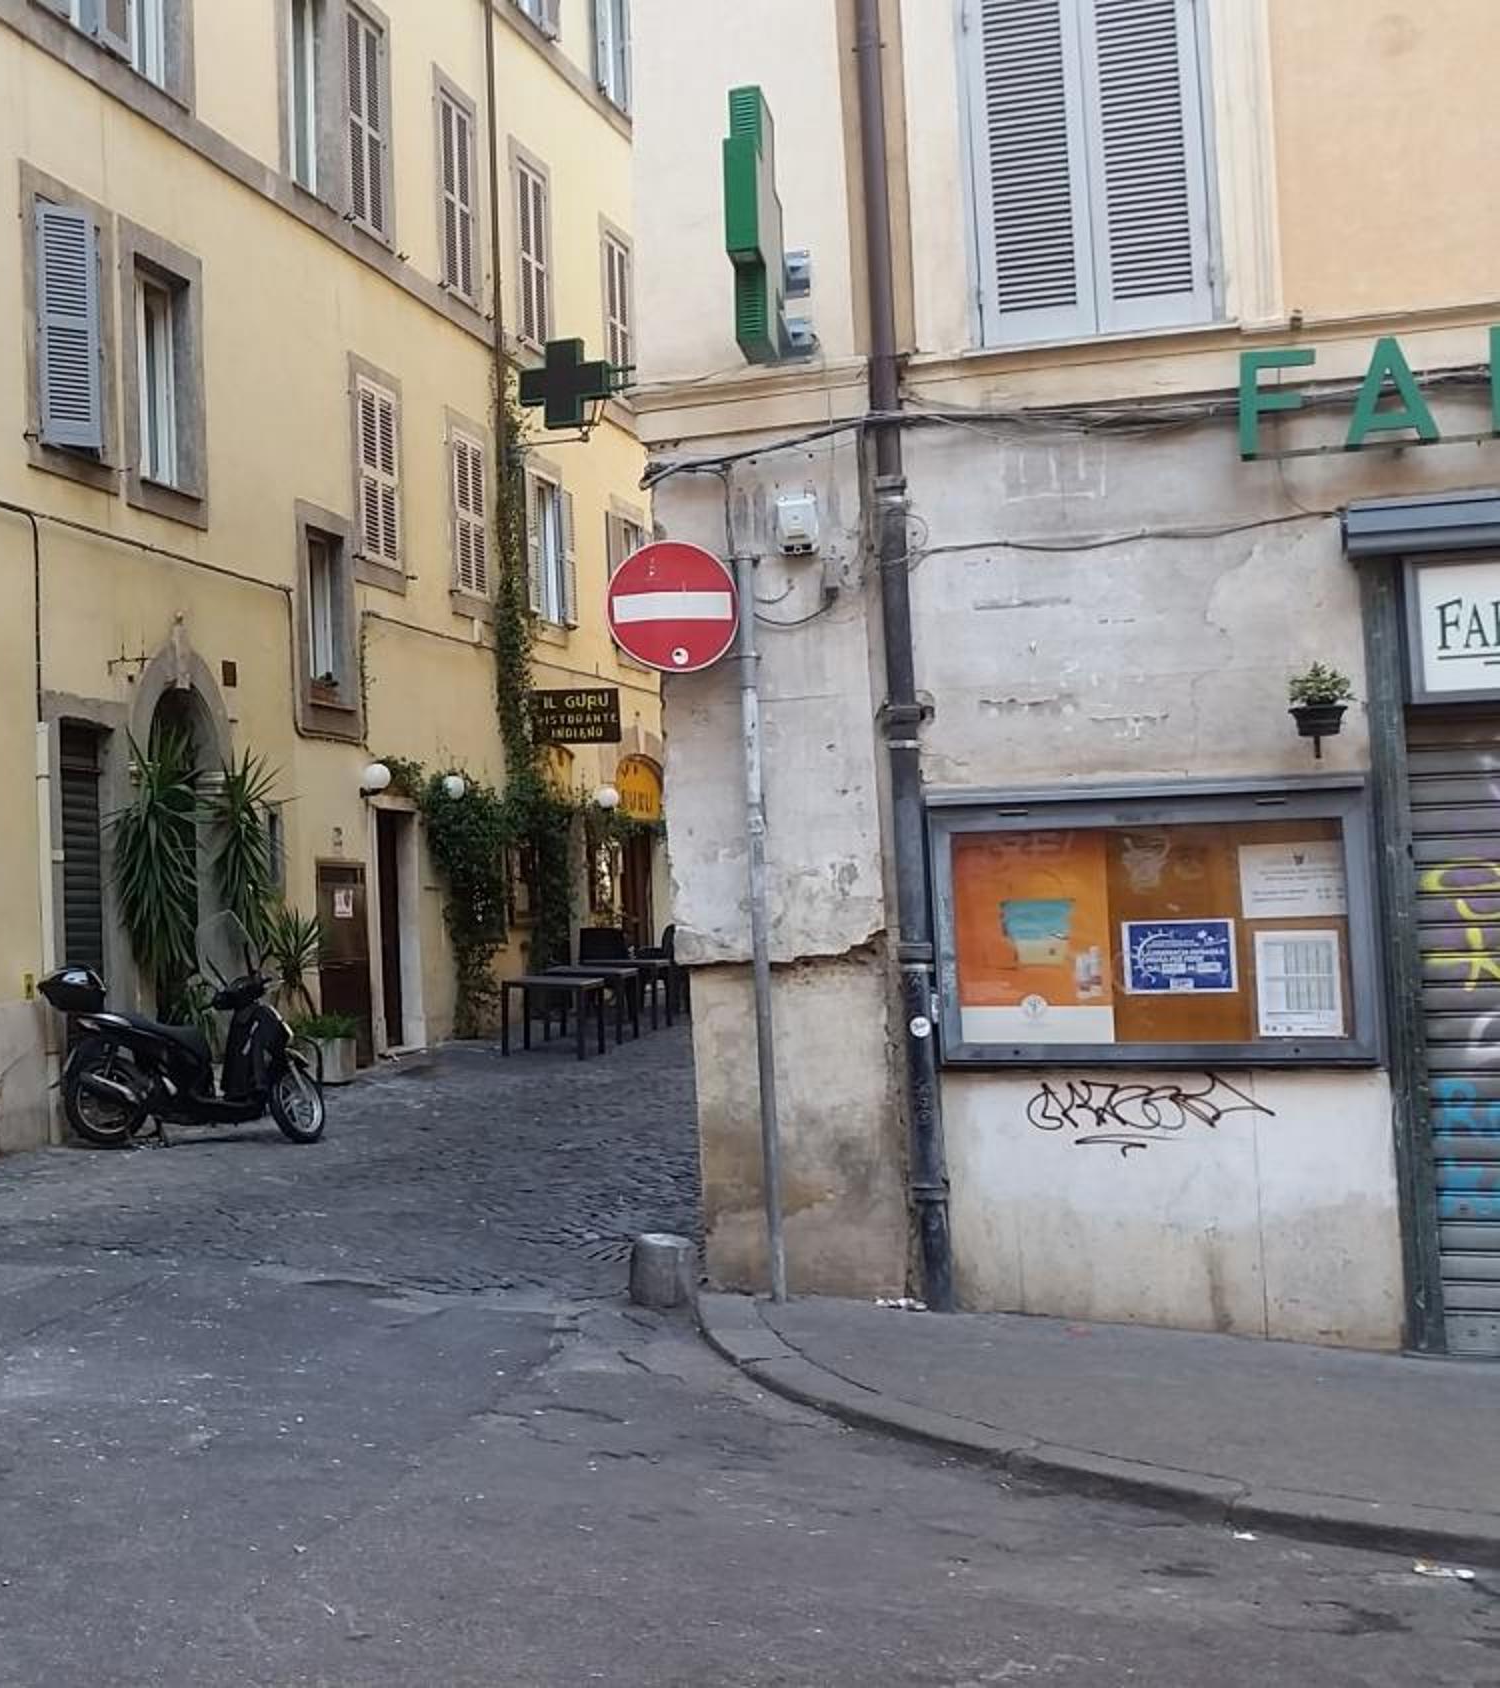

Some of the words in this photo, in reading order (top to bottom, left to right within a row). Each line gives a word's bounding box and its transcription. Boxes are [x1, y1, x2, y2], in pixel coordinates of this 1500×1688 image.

[1238, 325, 1500, 461] FA
[1436, 596, 1500, 651] FA
[543, 695, 557, 709] IL
[564, 691, 609, 711] GURU
